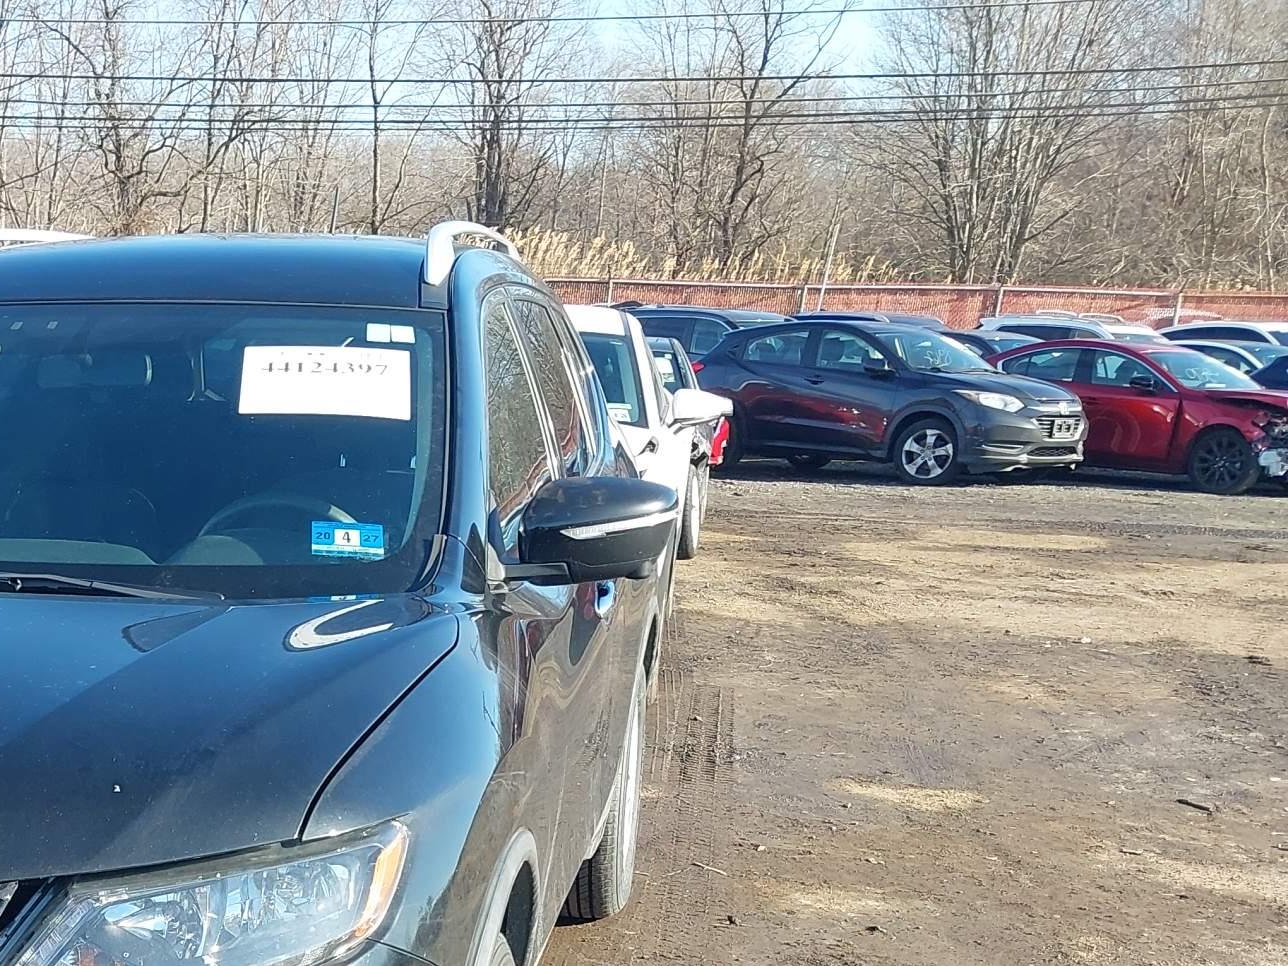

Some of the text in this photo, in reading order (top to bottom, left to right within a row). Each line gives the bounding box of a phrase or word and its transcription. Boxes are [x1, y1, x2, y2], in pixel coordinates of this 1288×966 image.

[261, 361, 389, 376] 44124397
[316, 531, 379, 543] 20 4 27
